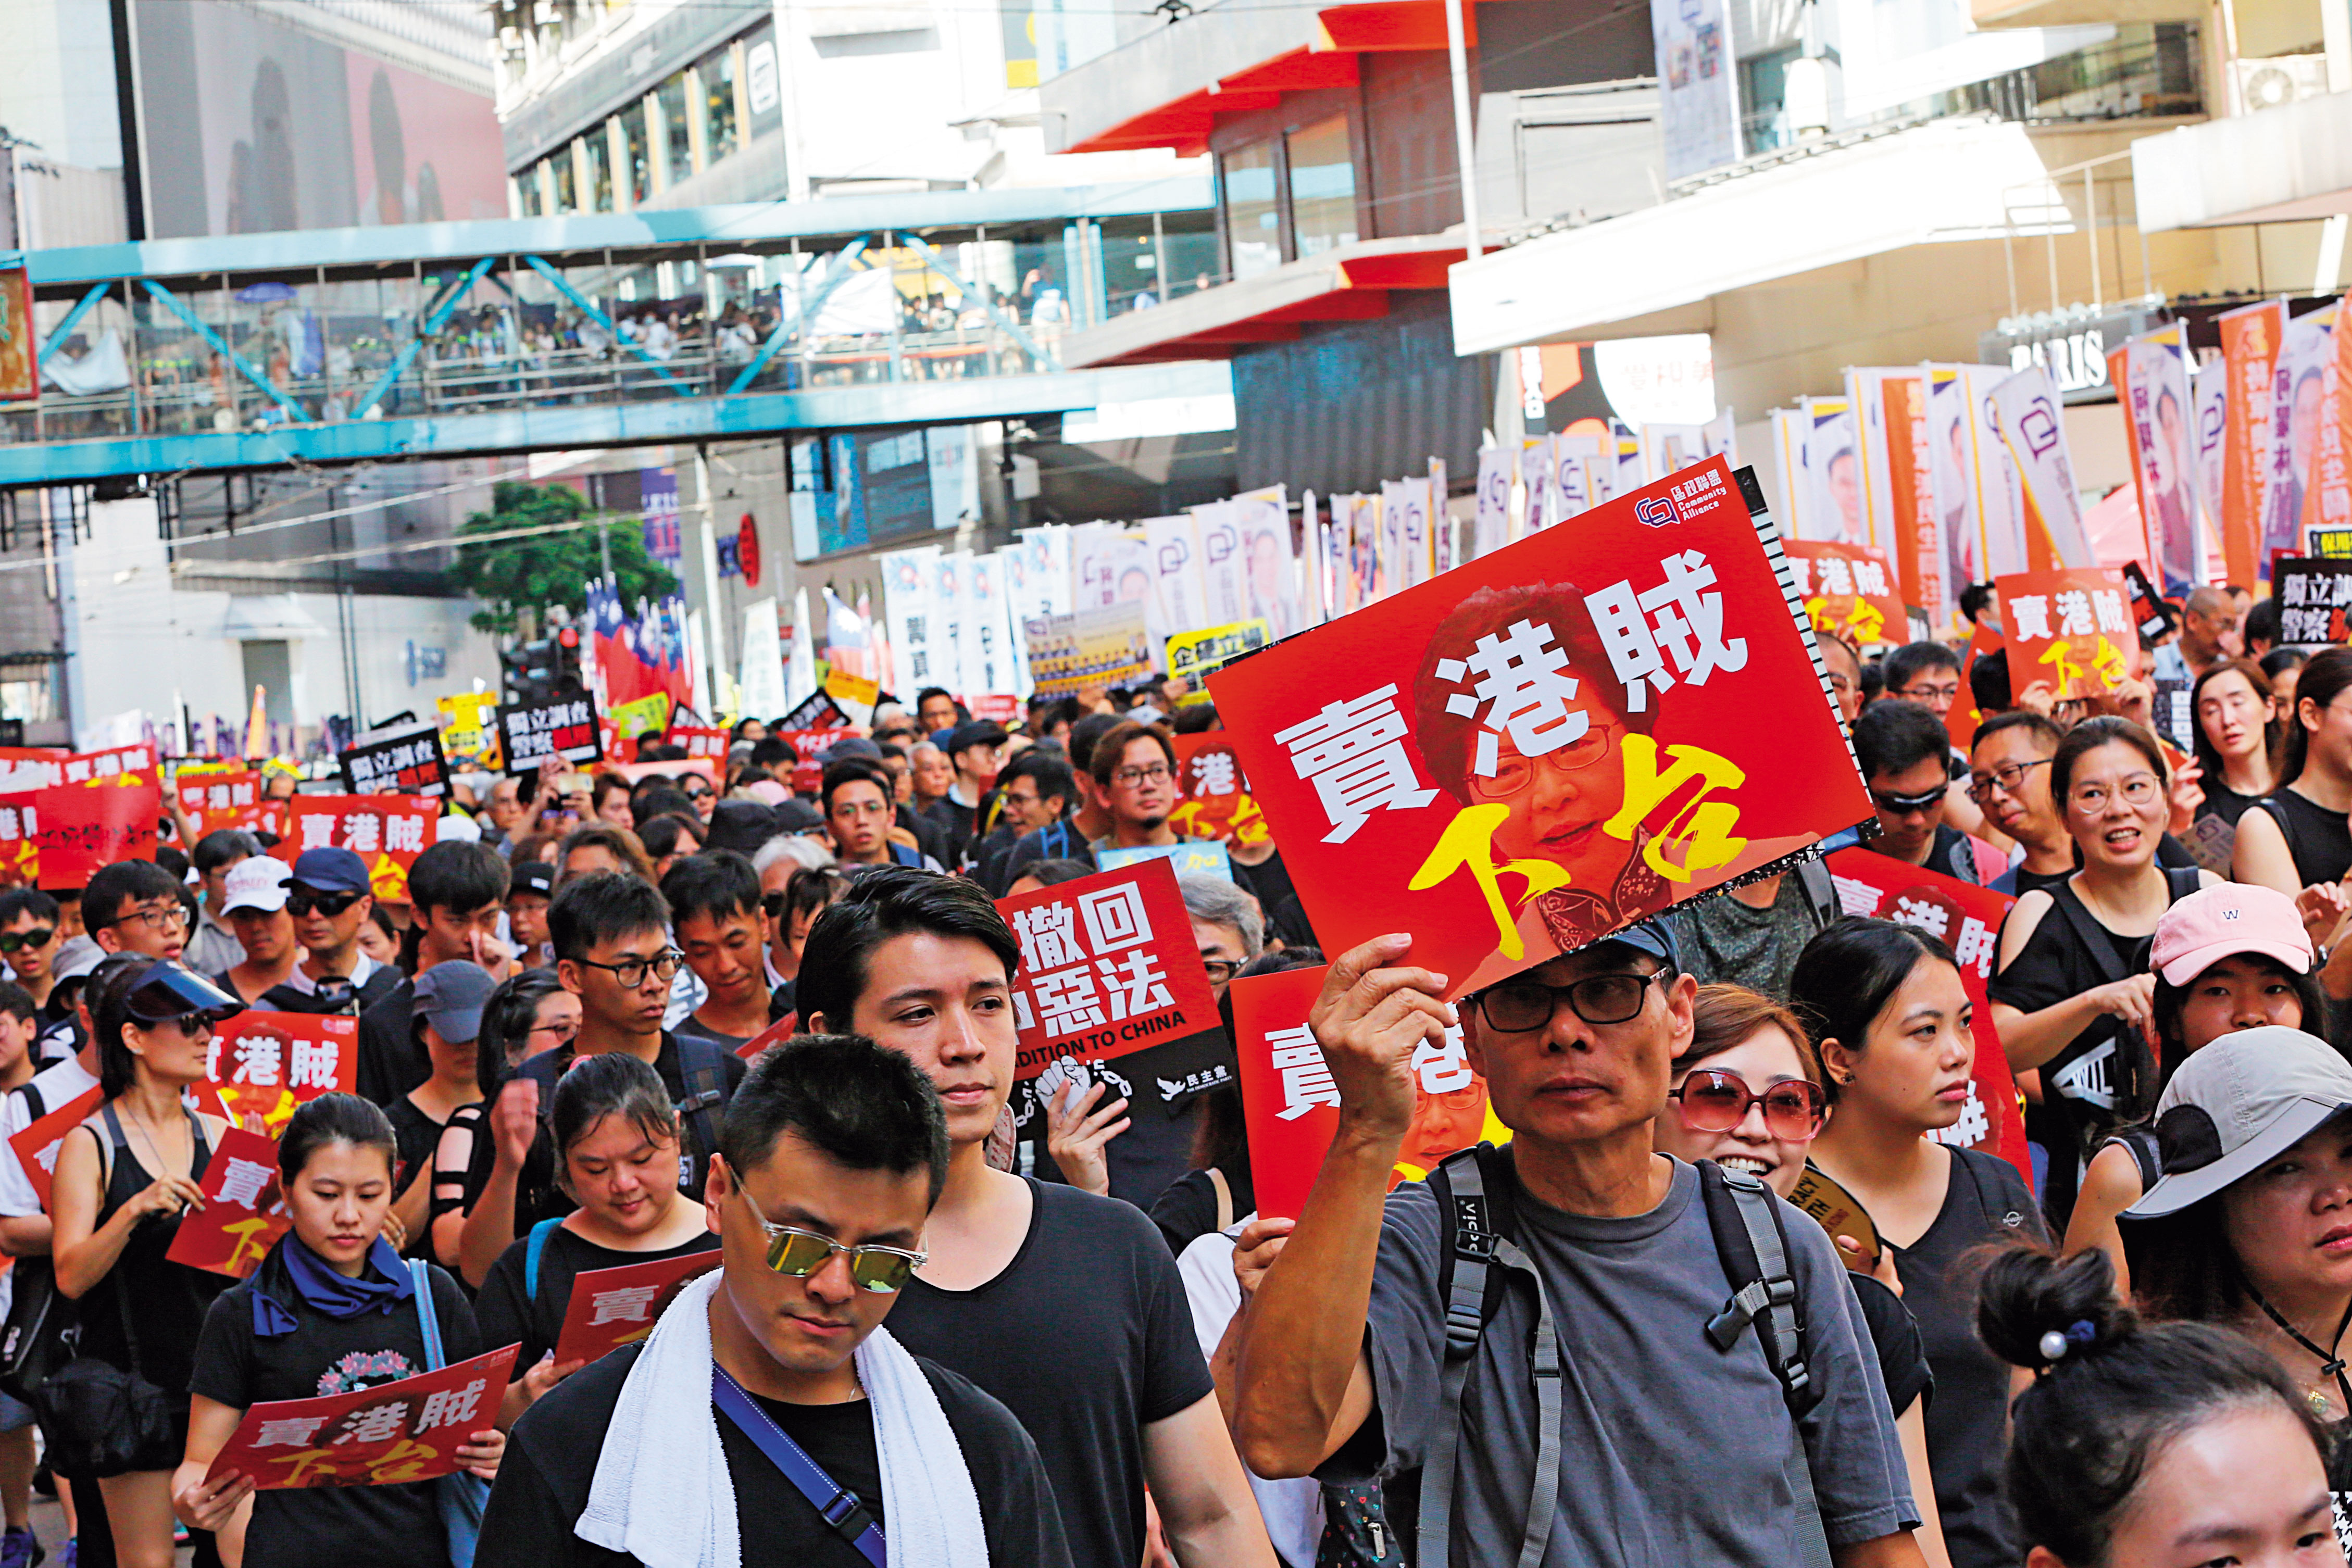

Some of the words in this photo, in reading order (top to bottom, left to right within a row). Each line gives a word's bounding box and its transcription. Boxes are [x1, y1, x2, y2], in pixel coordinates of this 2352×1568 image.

[2011, 330, 2107, 392] PRIS
[1670, 469, 1722, 502] 區政聯盟
[1678, 486, 1727, 511] Community
[1682, 500, 1720, 521] Alliance
[2009, 588, 2128, 643] 賣港賊
[2038, 635, 2128, 696] 下台
[1273, 548, 1748, 844] 賣港賊
[300, 813, 424, 852] 賣港賊
[1408, 732, 1747, 960] 下台
[2222, 909, 2239, 920] W
[1091, 1031, 1116, 1051] TO
[1120, 1010, 1187, 1042] CHINA
[247, 1377, 487, 1448] 賣港賊
[267, 1438, 438, 1486] 下台
